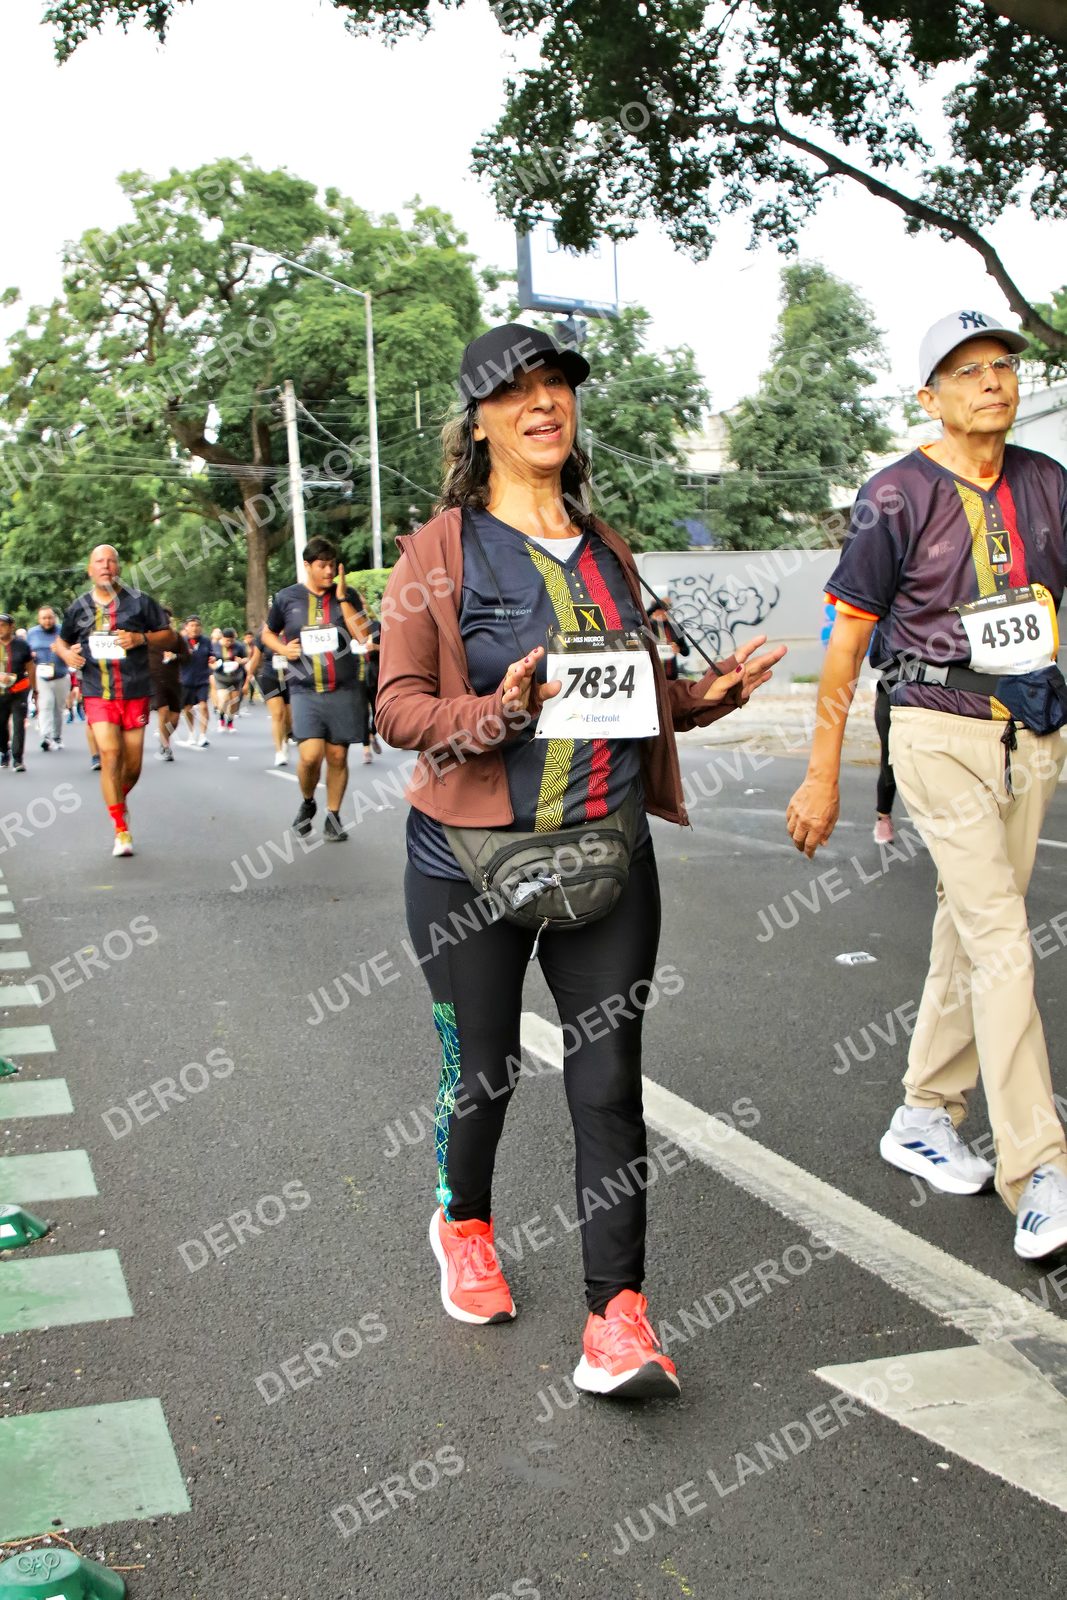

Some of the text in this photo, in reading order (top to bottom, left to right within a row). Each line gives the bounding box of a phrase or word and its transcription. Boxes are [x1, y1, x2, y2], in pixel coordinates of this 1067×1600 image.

[668, 573, 715, 591] TOY
[981, 613, 1041, 649] 4538
[562, 664, 635, 699] 7834
[585, 713, 620, 723] Electrolit
